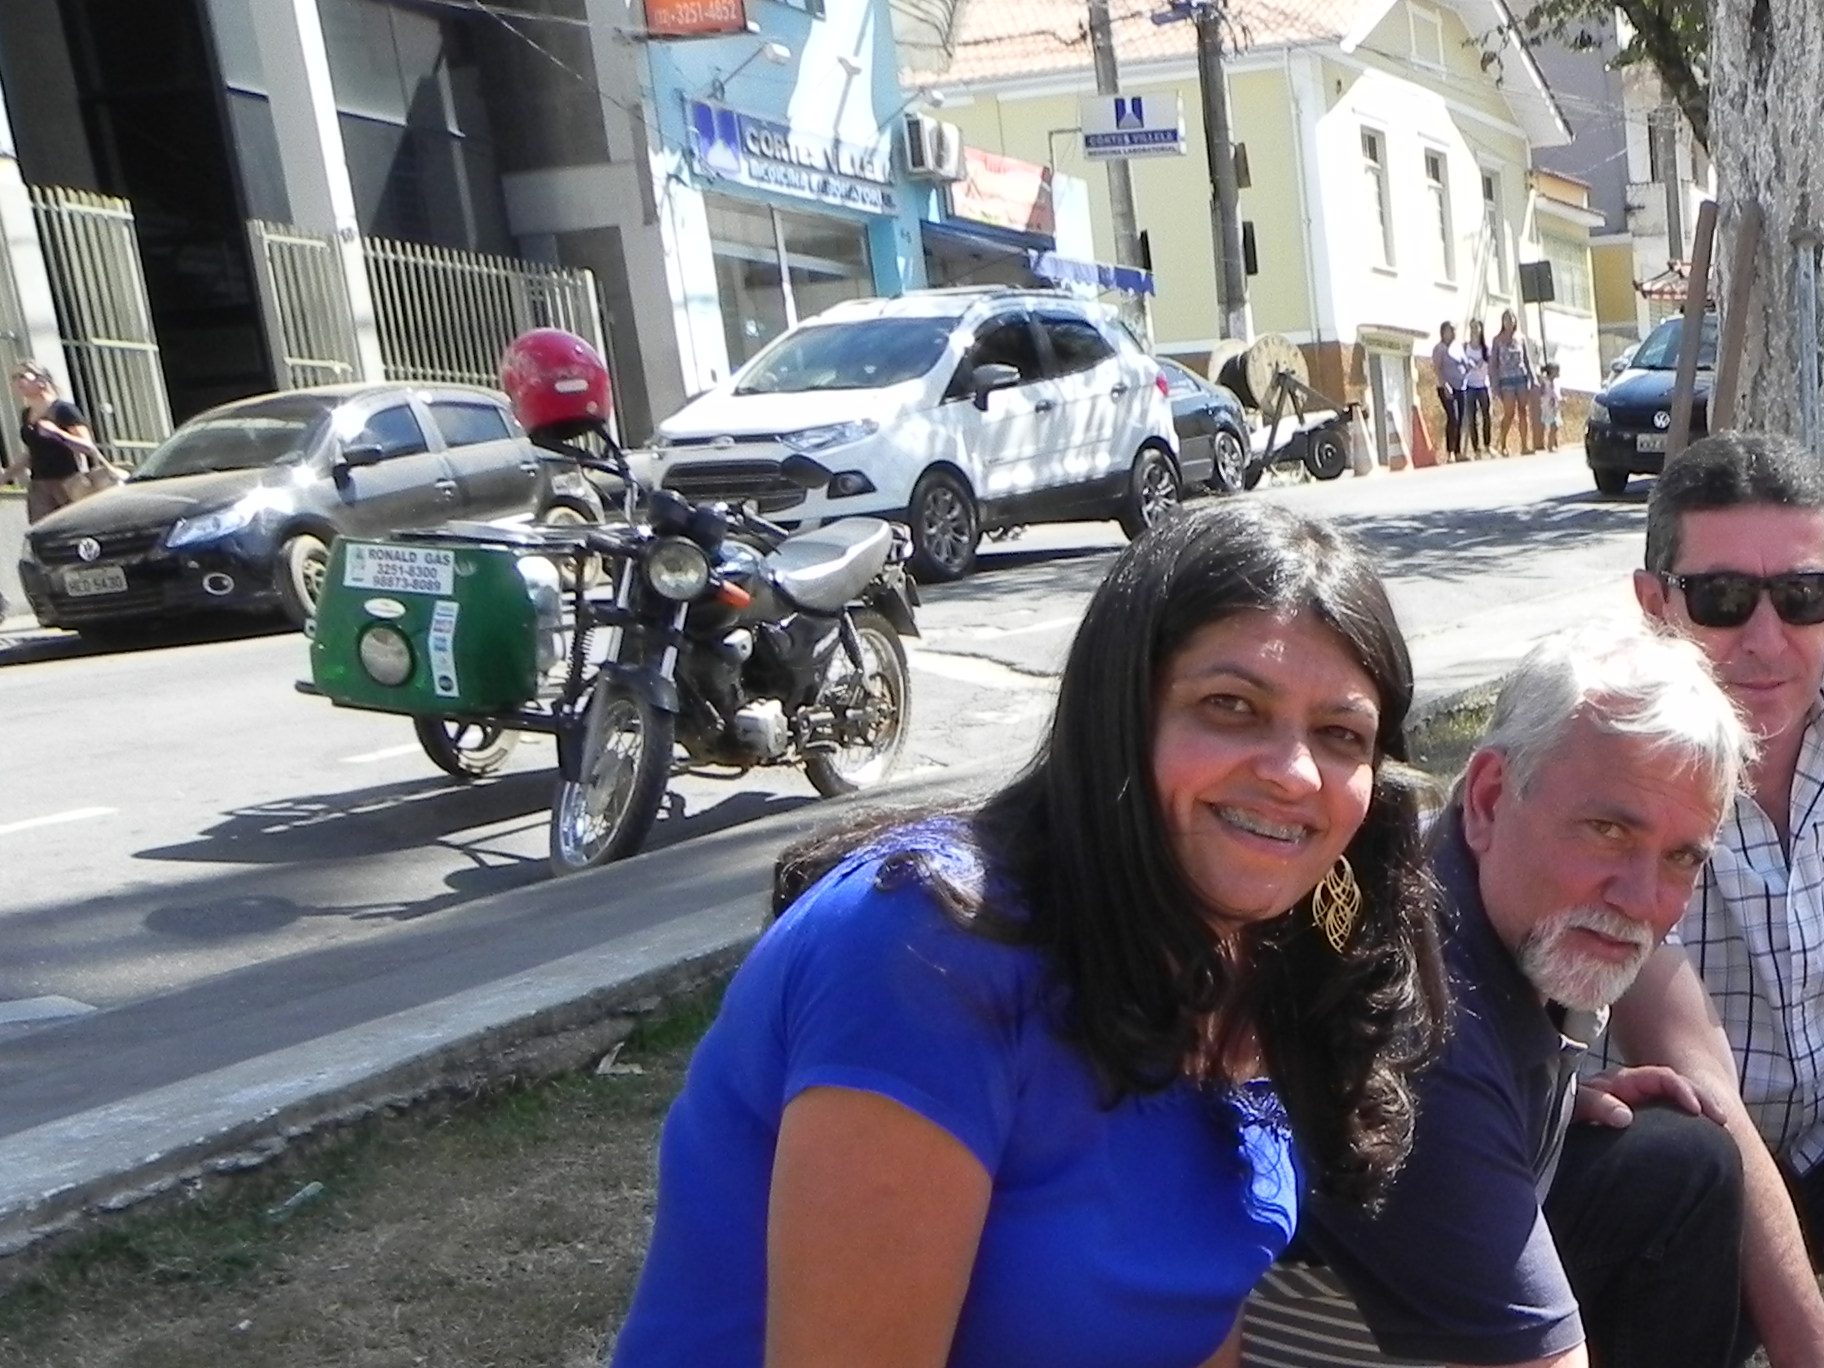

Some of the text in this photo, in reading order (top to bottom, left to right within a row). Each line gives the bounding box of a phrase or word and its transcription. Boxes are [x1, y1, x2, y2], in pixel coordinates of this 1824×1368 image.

[368, 549, 451, 566] RONALD GAS
[377, 563, 438, 578] 3251-8300
